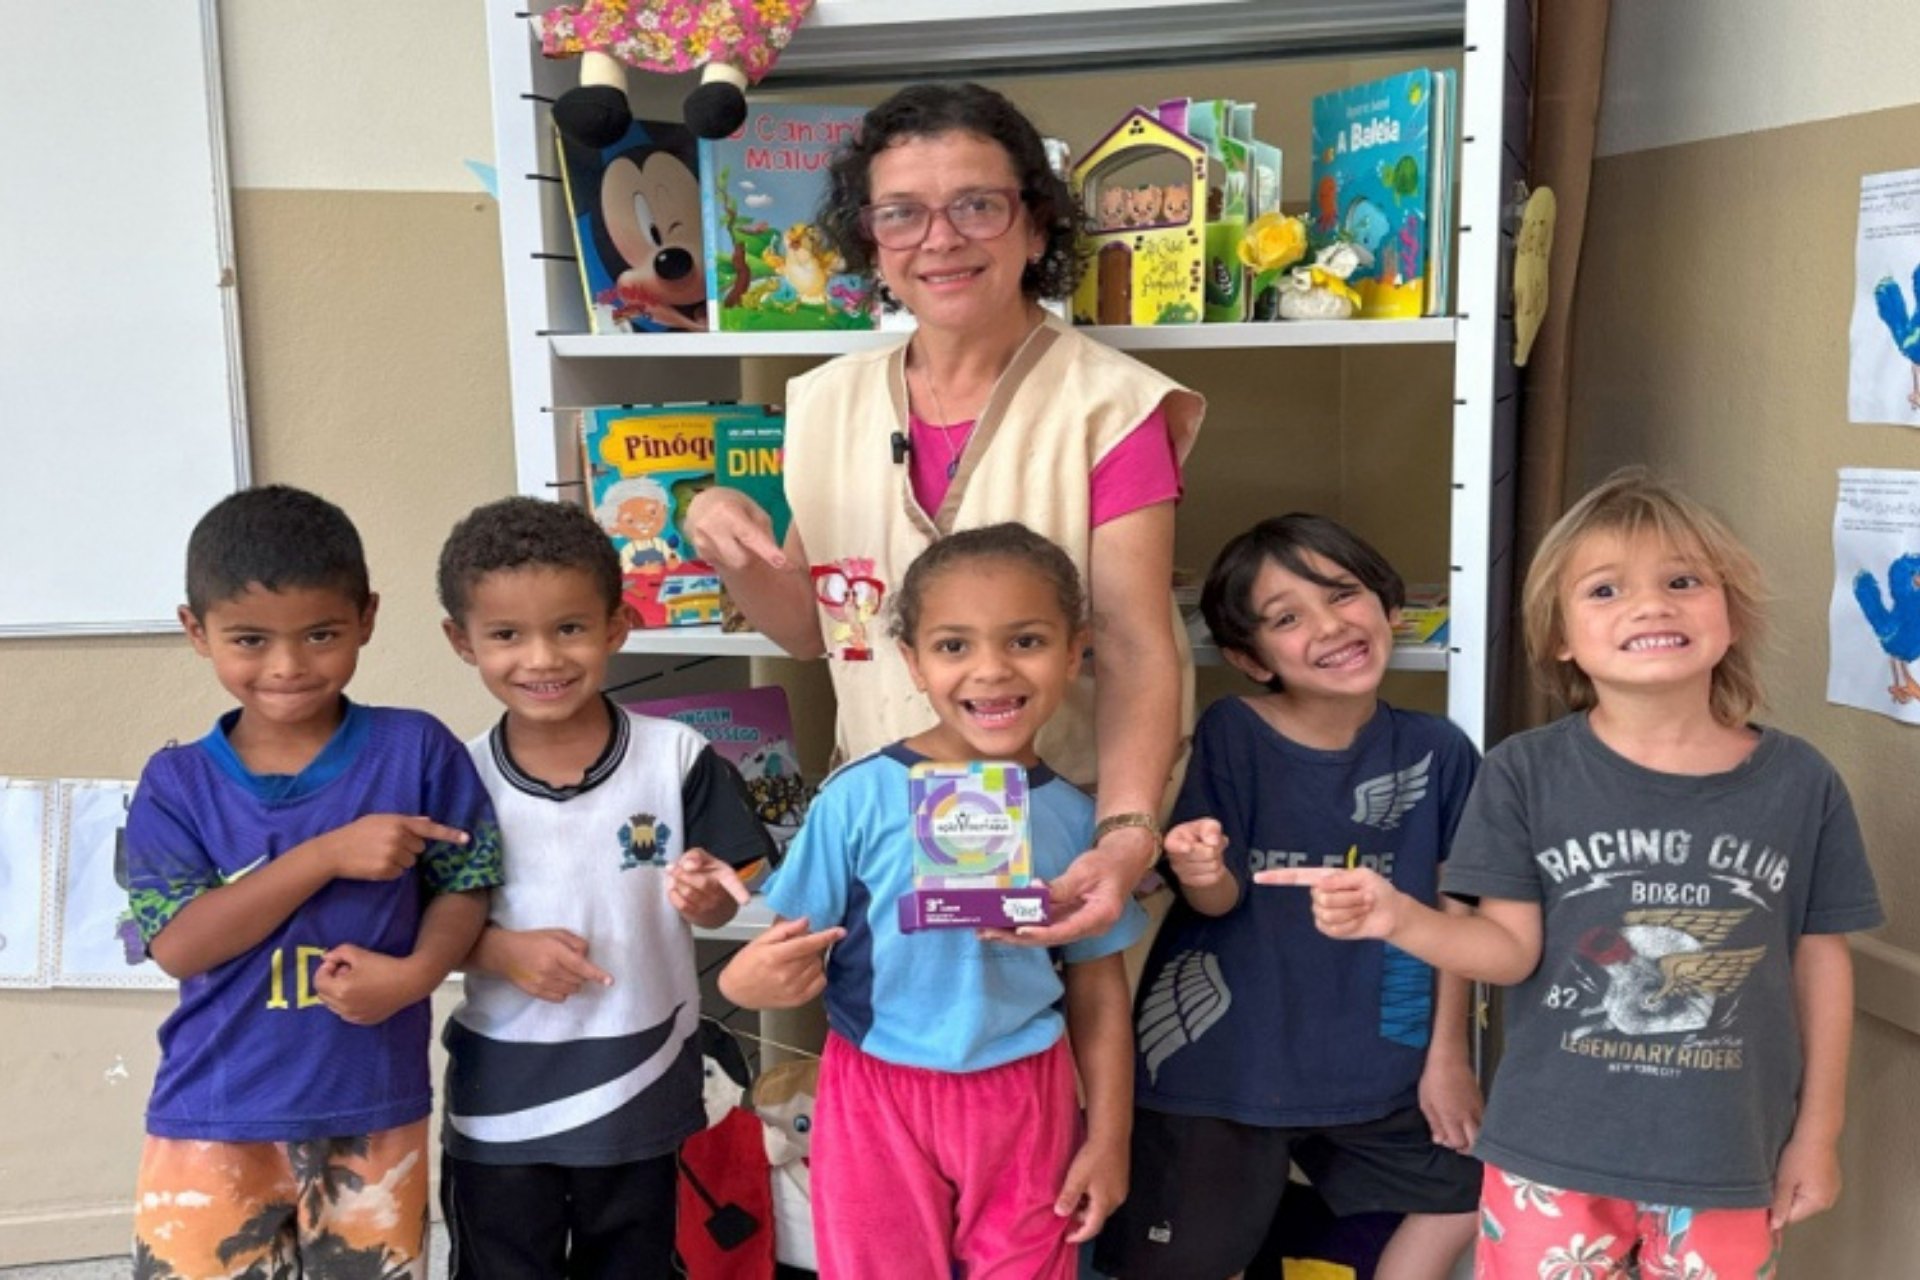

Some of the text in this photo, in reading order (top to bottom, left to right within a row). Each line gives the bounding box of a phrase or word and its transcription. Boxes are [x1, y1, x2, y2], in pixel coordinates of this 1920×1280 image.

[755, 110, 865, 146] Canári
[1336, 116, 1400, 154] A Baleia
[745, 146, 834, 171] Maluc
[624, 433, 715, 462] Pinóq
[727, 448, 784, 478] DIN
[1535, 829, 1790, 893] RACING CLUB
[1631, 880, 1710, 906] BD&CO
[1560, 1031, 1676, 1066] LEGENDARY
[1677, 1048, 1743, 1071] RIDERS
